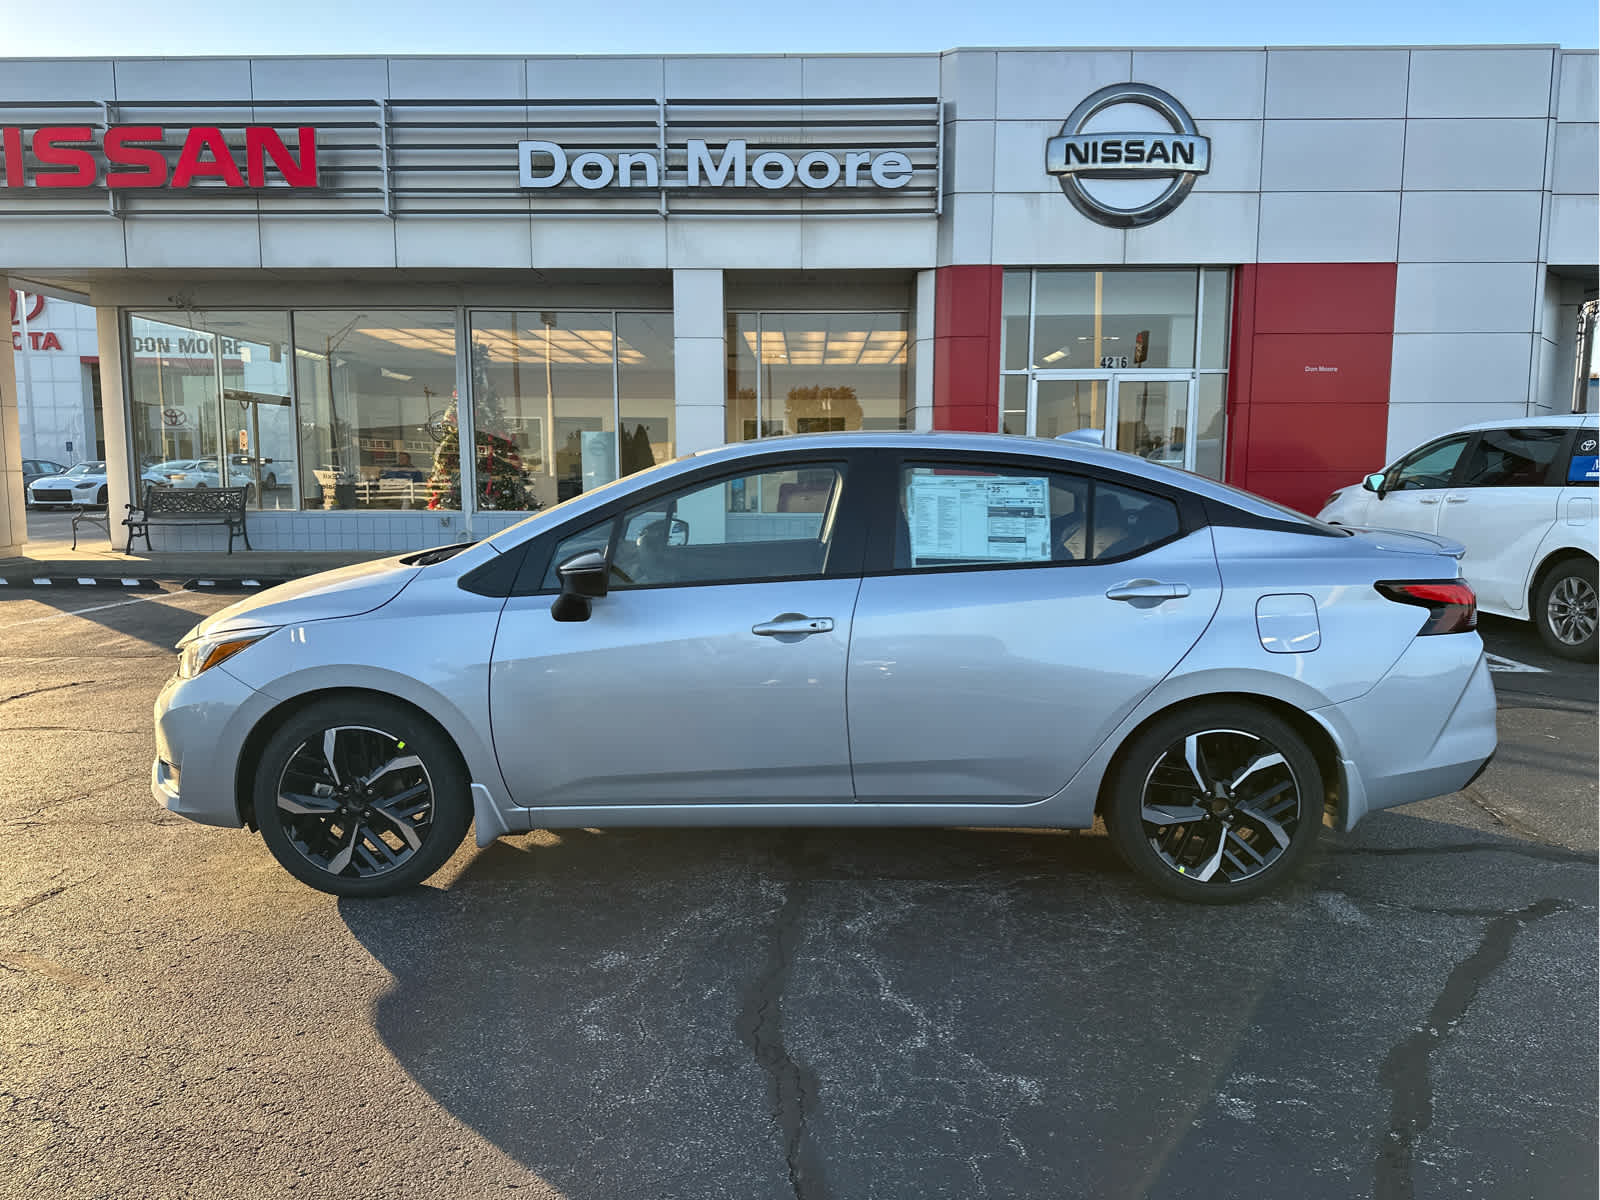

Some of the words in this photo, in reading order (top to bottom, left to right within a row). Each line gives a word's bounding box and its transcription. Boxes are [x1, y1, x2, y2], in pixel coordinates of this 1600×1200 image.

[1064, 140, 1194, 165] NISSAN
[518, 140, 659, 190] Don
[686, 139, 913, 190] Moore
[132, 337, 170, 353] DON
[1100, 356, 1128, 369] 4216
